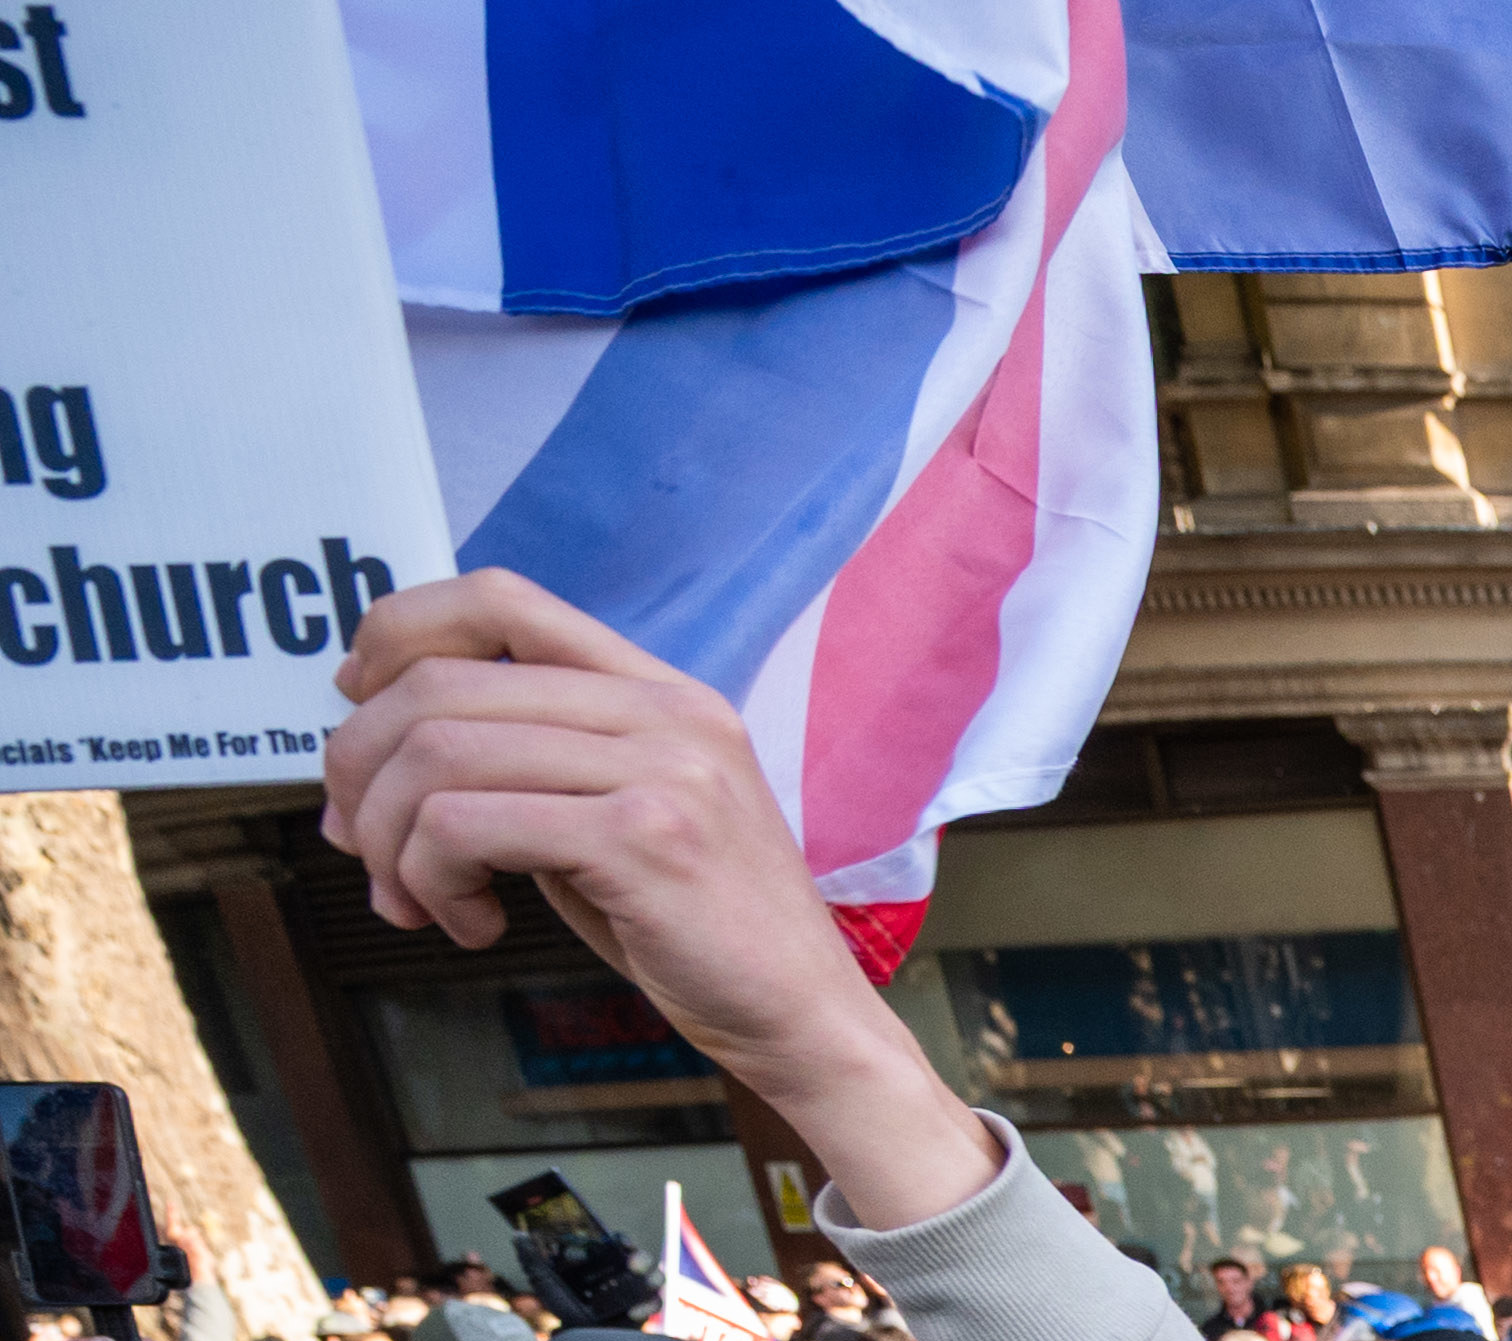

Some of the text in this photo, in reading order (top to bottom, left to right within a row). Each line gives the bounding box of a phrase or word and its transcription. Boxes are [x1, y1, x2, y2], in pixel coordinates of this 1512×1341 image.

[0, 538, 396, 668] church
[166, 733, 210, 759] Me
[215, 730, 260, 757] For
[264, 728, 319, 755] The
